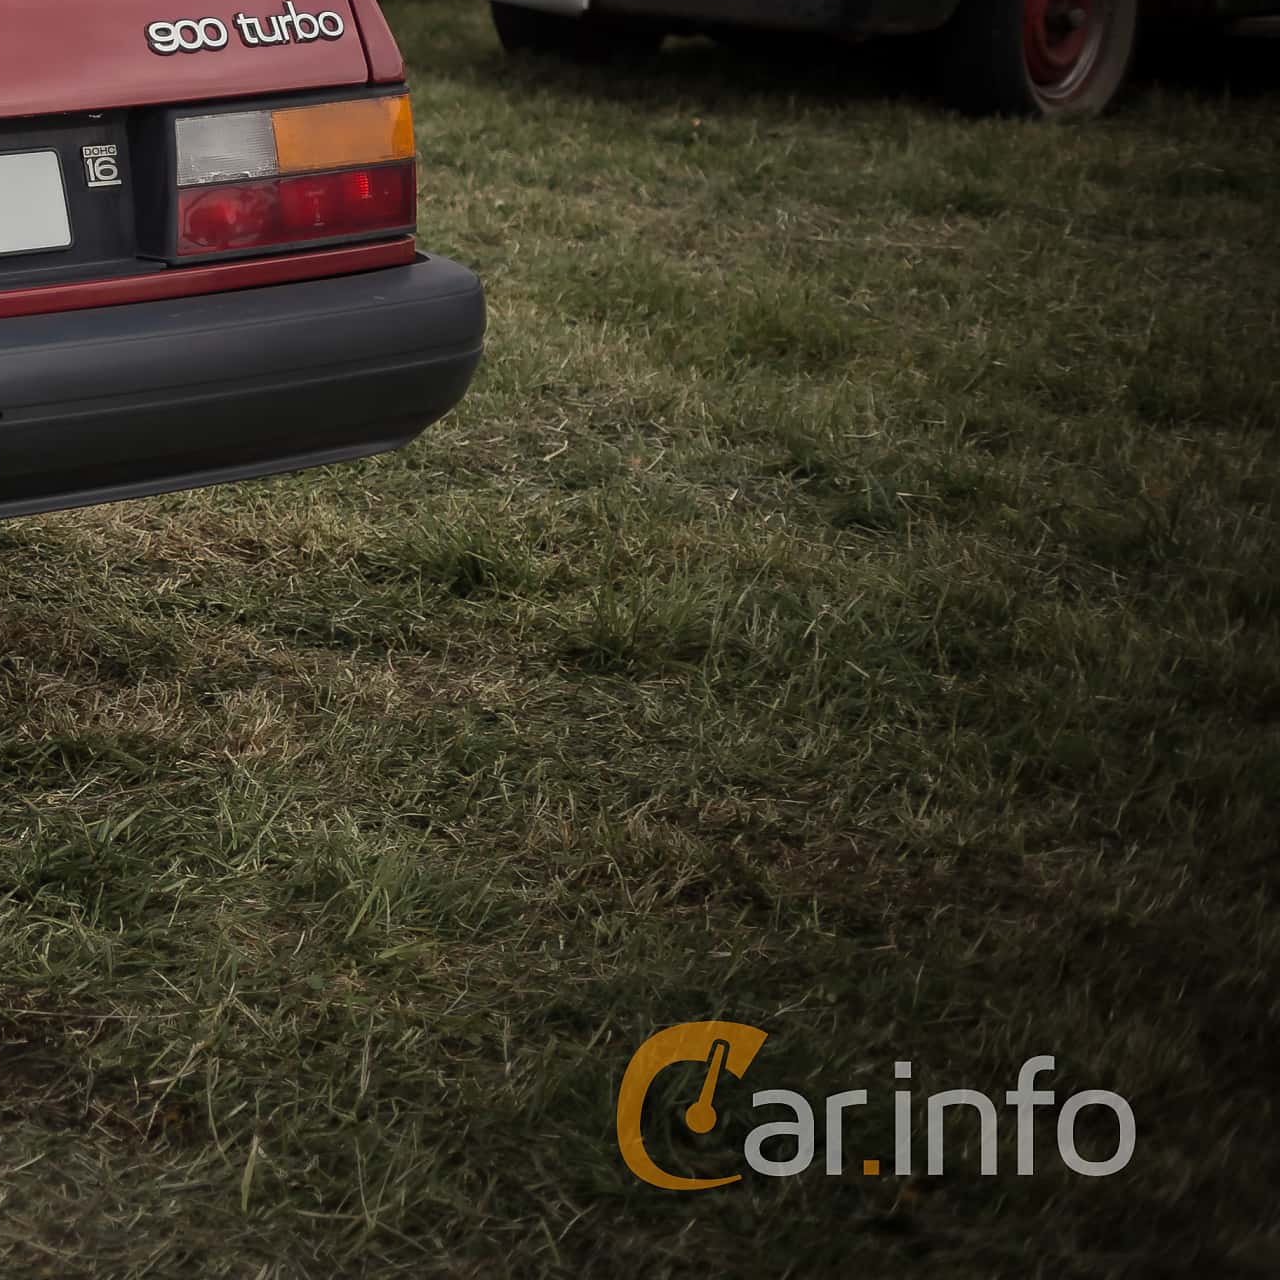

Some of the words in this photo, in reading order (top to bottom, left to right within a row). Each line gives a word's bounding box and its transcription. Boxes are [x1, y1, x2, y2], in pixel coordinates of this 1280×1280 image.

[144, 19, 228, 55] 900
[233, 0, 345, 47] turbo
[83, 145, 117, 157] DOHC
[86, 156, 118, 181] 16
